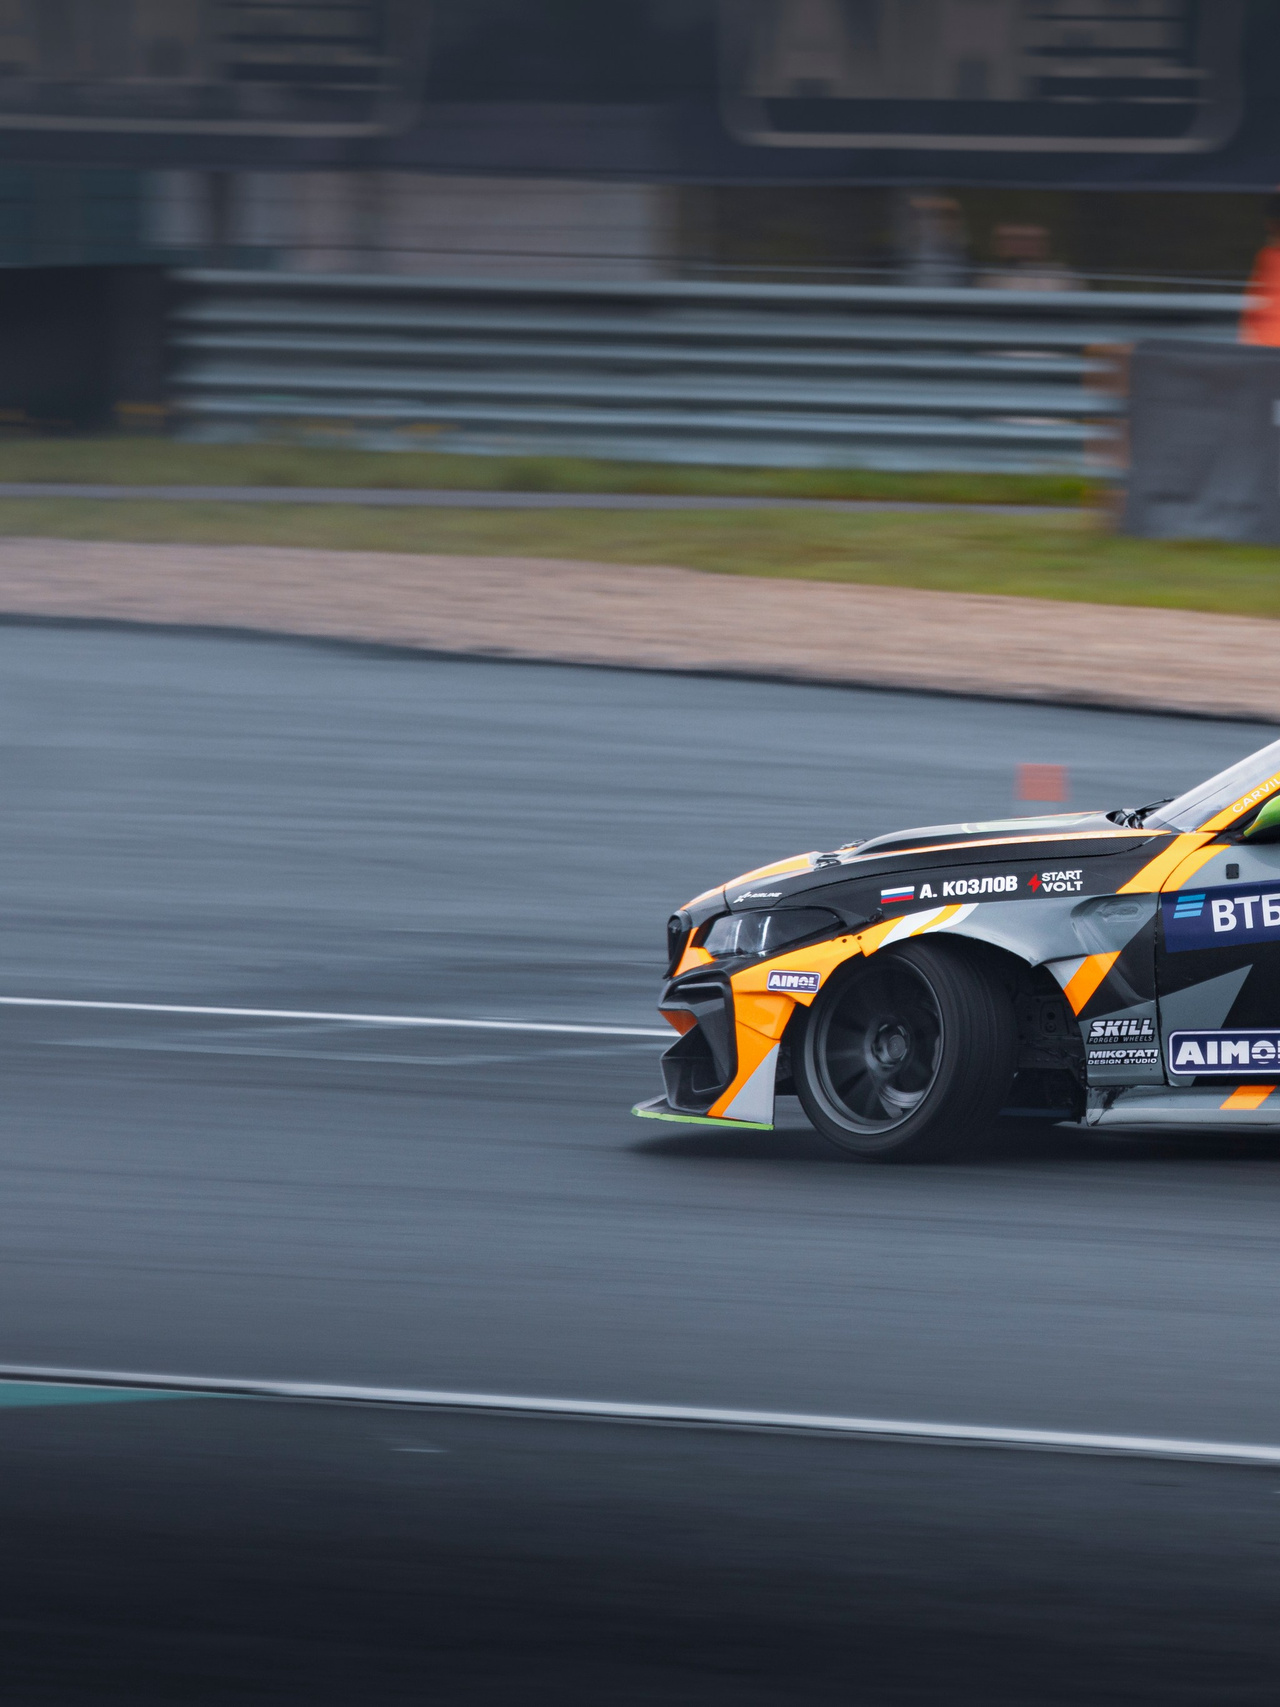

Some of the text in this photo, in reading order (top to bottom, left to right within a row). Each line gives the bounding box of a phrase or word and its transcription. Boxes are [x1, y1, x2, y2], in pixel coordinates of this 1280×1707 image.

[1041, 869, 1083, 881] START
[919, 875, 1018, 899] А. КОЗЛОВ
[1042, 881, 1084, 893] VOLT
[1090, 1019, 1154, 1037] SKILL
[1089, 1049, 1159, 1059] MIKOTATI
